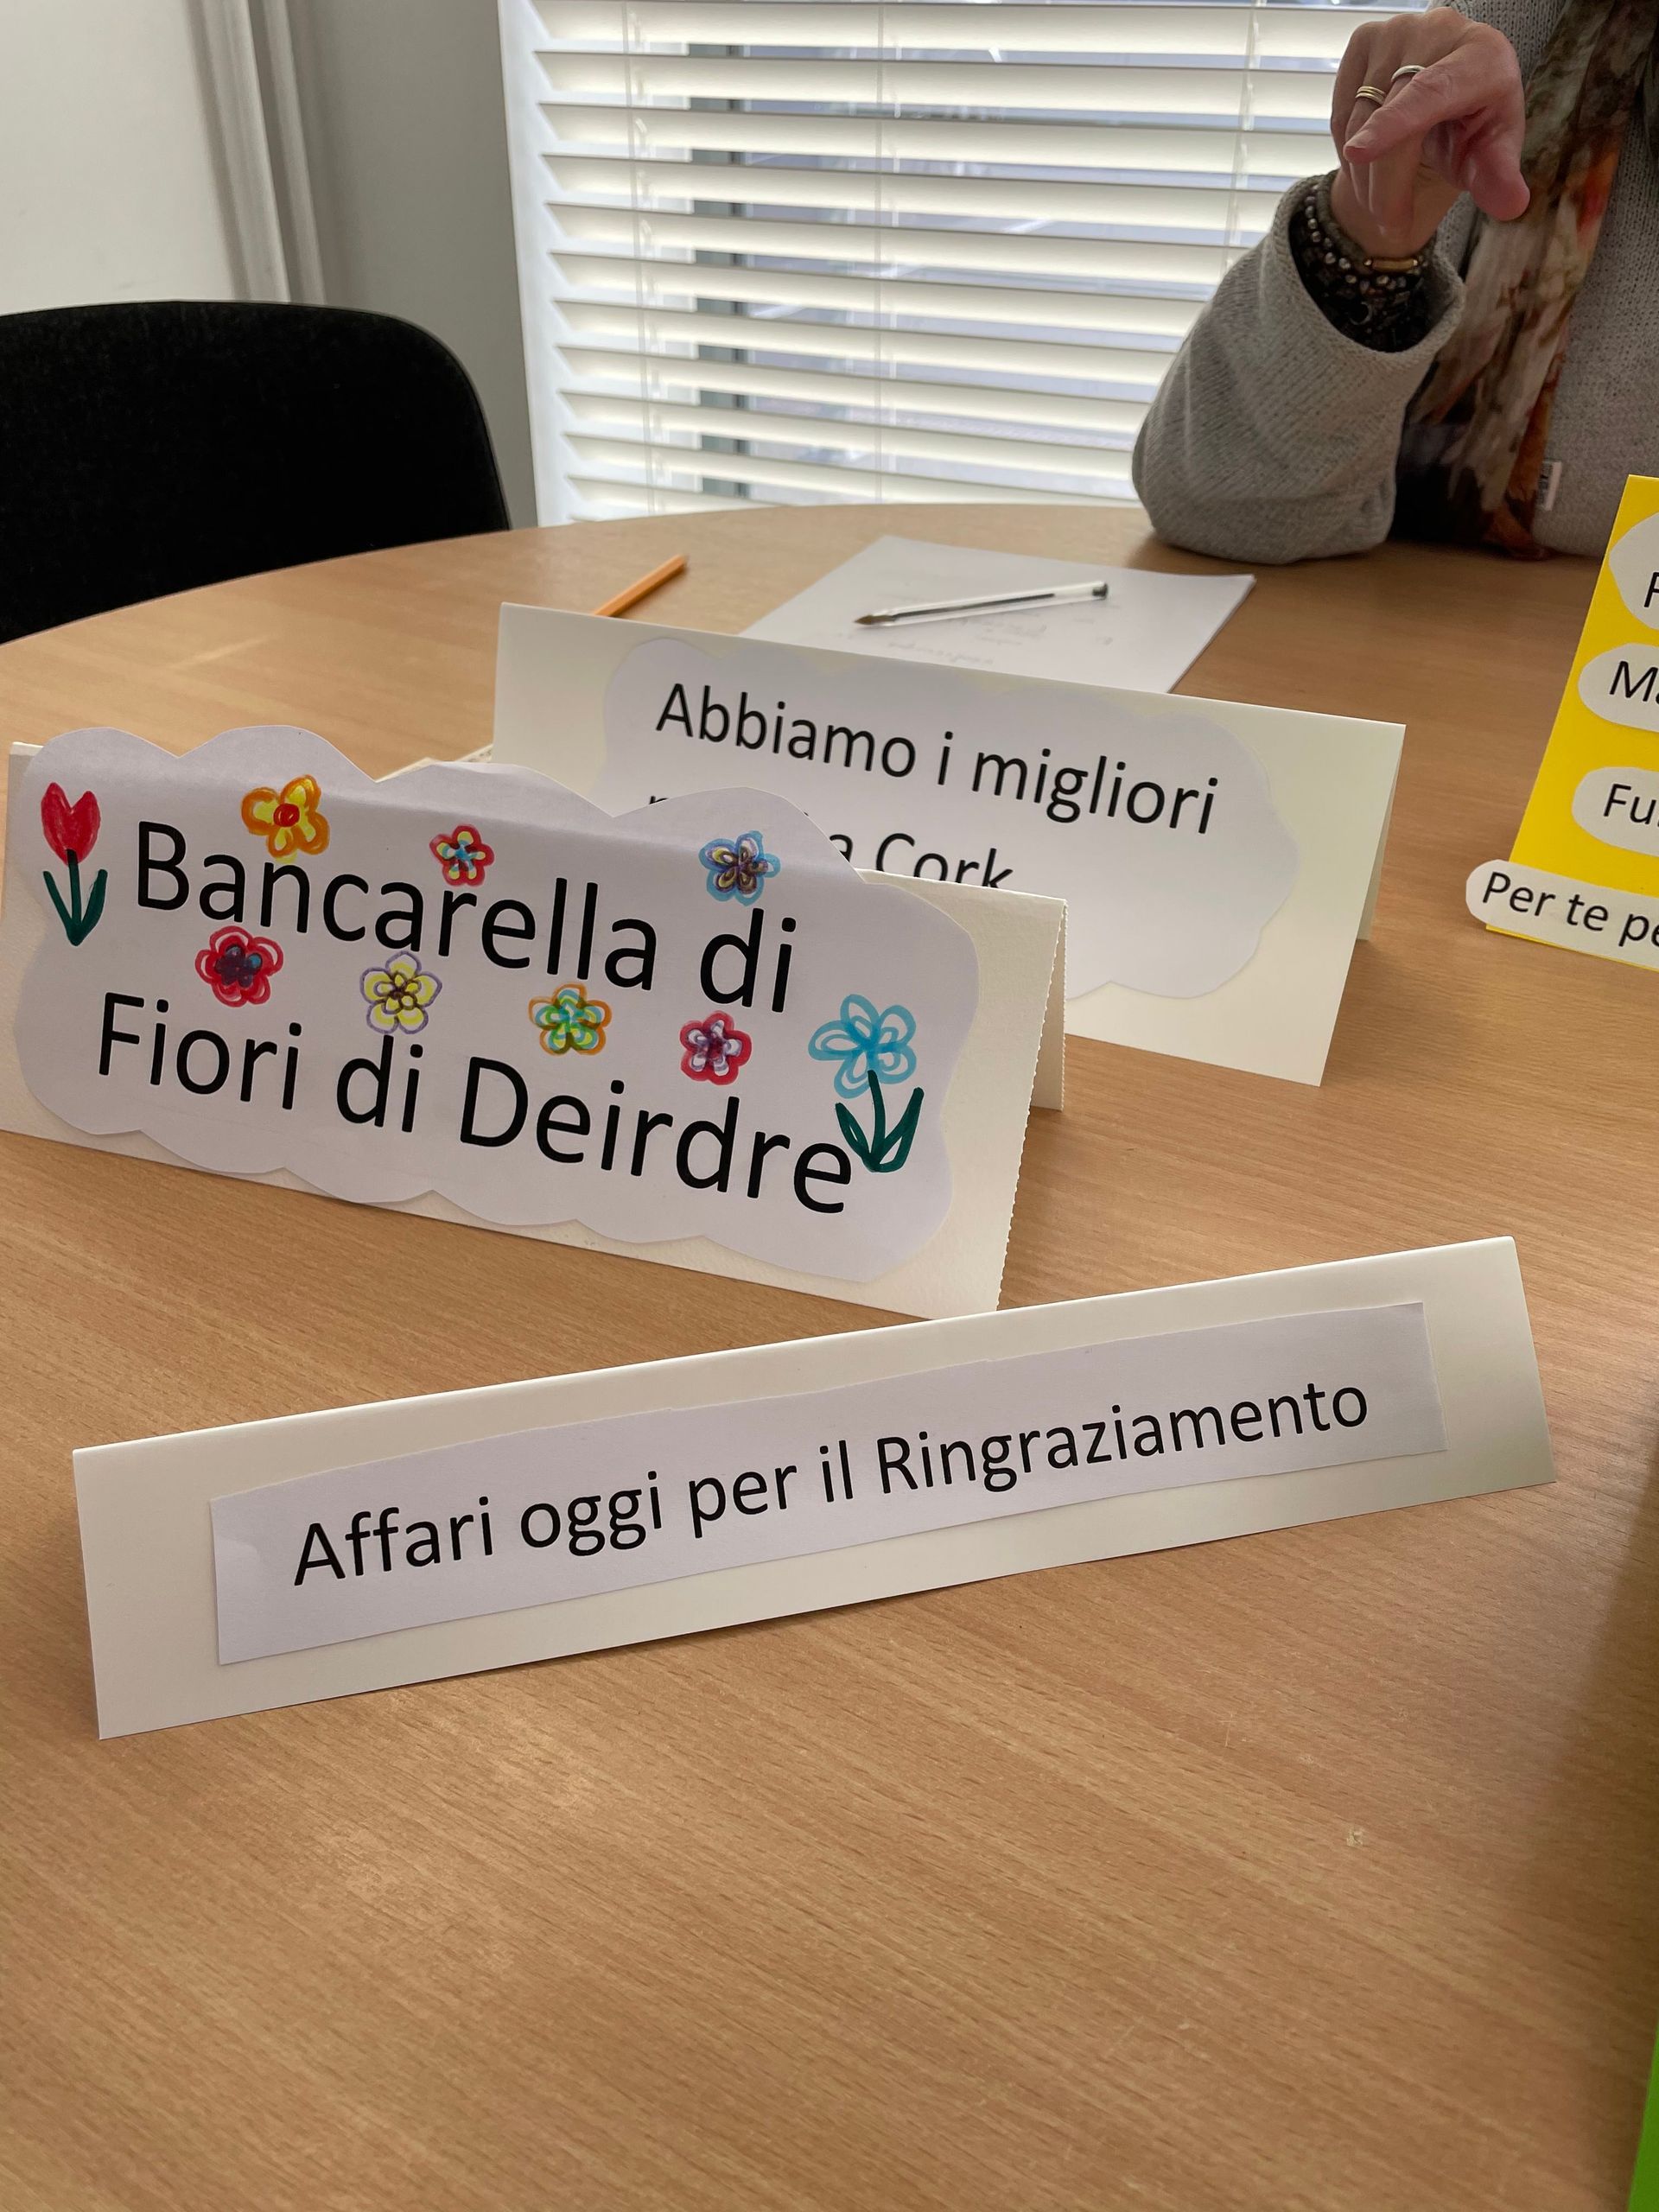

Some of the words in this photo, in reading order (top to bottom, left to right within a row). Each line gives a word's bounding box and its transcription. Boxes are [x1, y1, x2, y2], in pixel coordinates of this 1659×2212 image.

[1609, 660, 1659, 705] M
[655, 683, 916, 778] Abbiamo
[938, 730, 954, 785] i
[971, 747, 1219, 835] migliori
[1603, 783, 1659, 827] Fu
[875, 832, 1014, 890] Cork
[1482, 871, 1556, 917] Per
[1566, 893, 1609, 931] te
[137, 820, 657, 992] Bancarella
[699, 907, 798, 1014] di
[98, 991, 302, 1110] Fiori
[335, 1033, 423, 1133] di
[460, 1056, 852, 1214] Deirdre
[294, 1496, 493, 1586] Affari
[520, 1470, 662, 1557] oggi
[689, 1465, 798, 1539] per
[819, 1439, 855, 1503] il
[875, 1382, 1368, 1494] Ringraziamento
